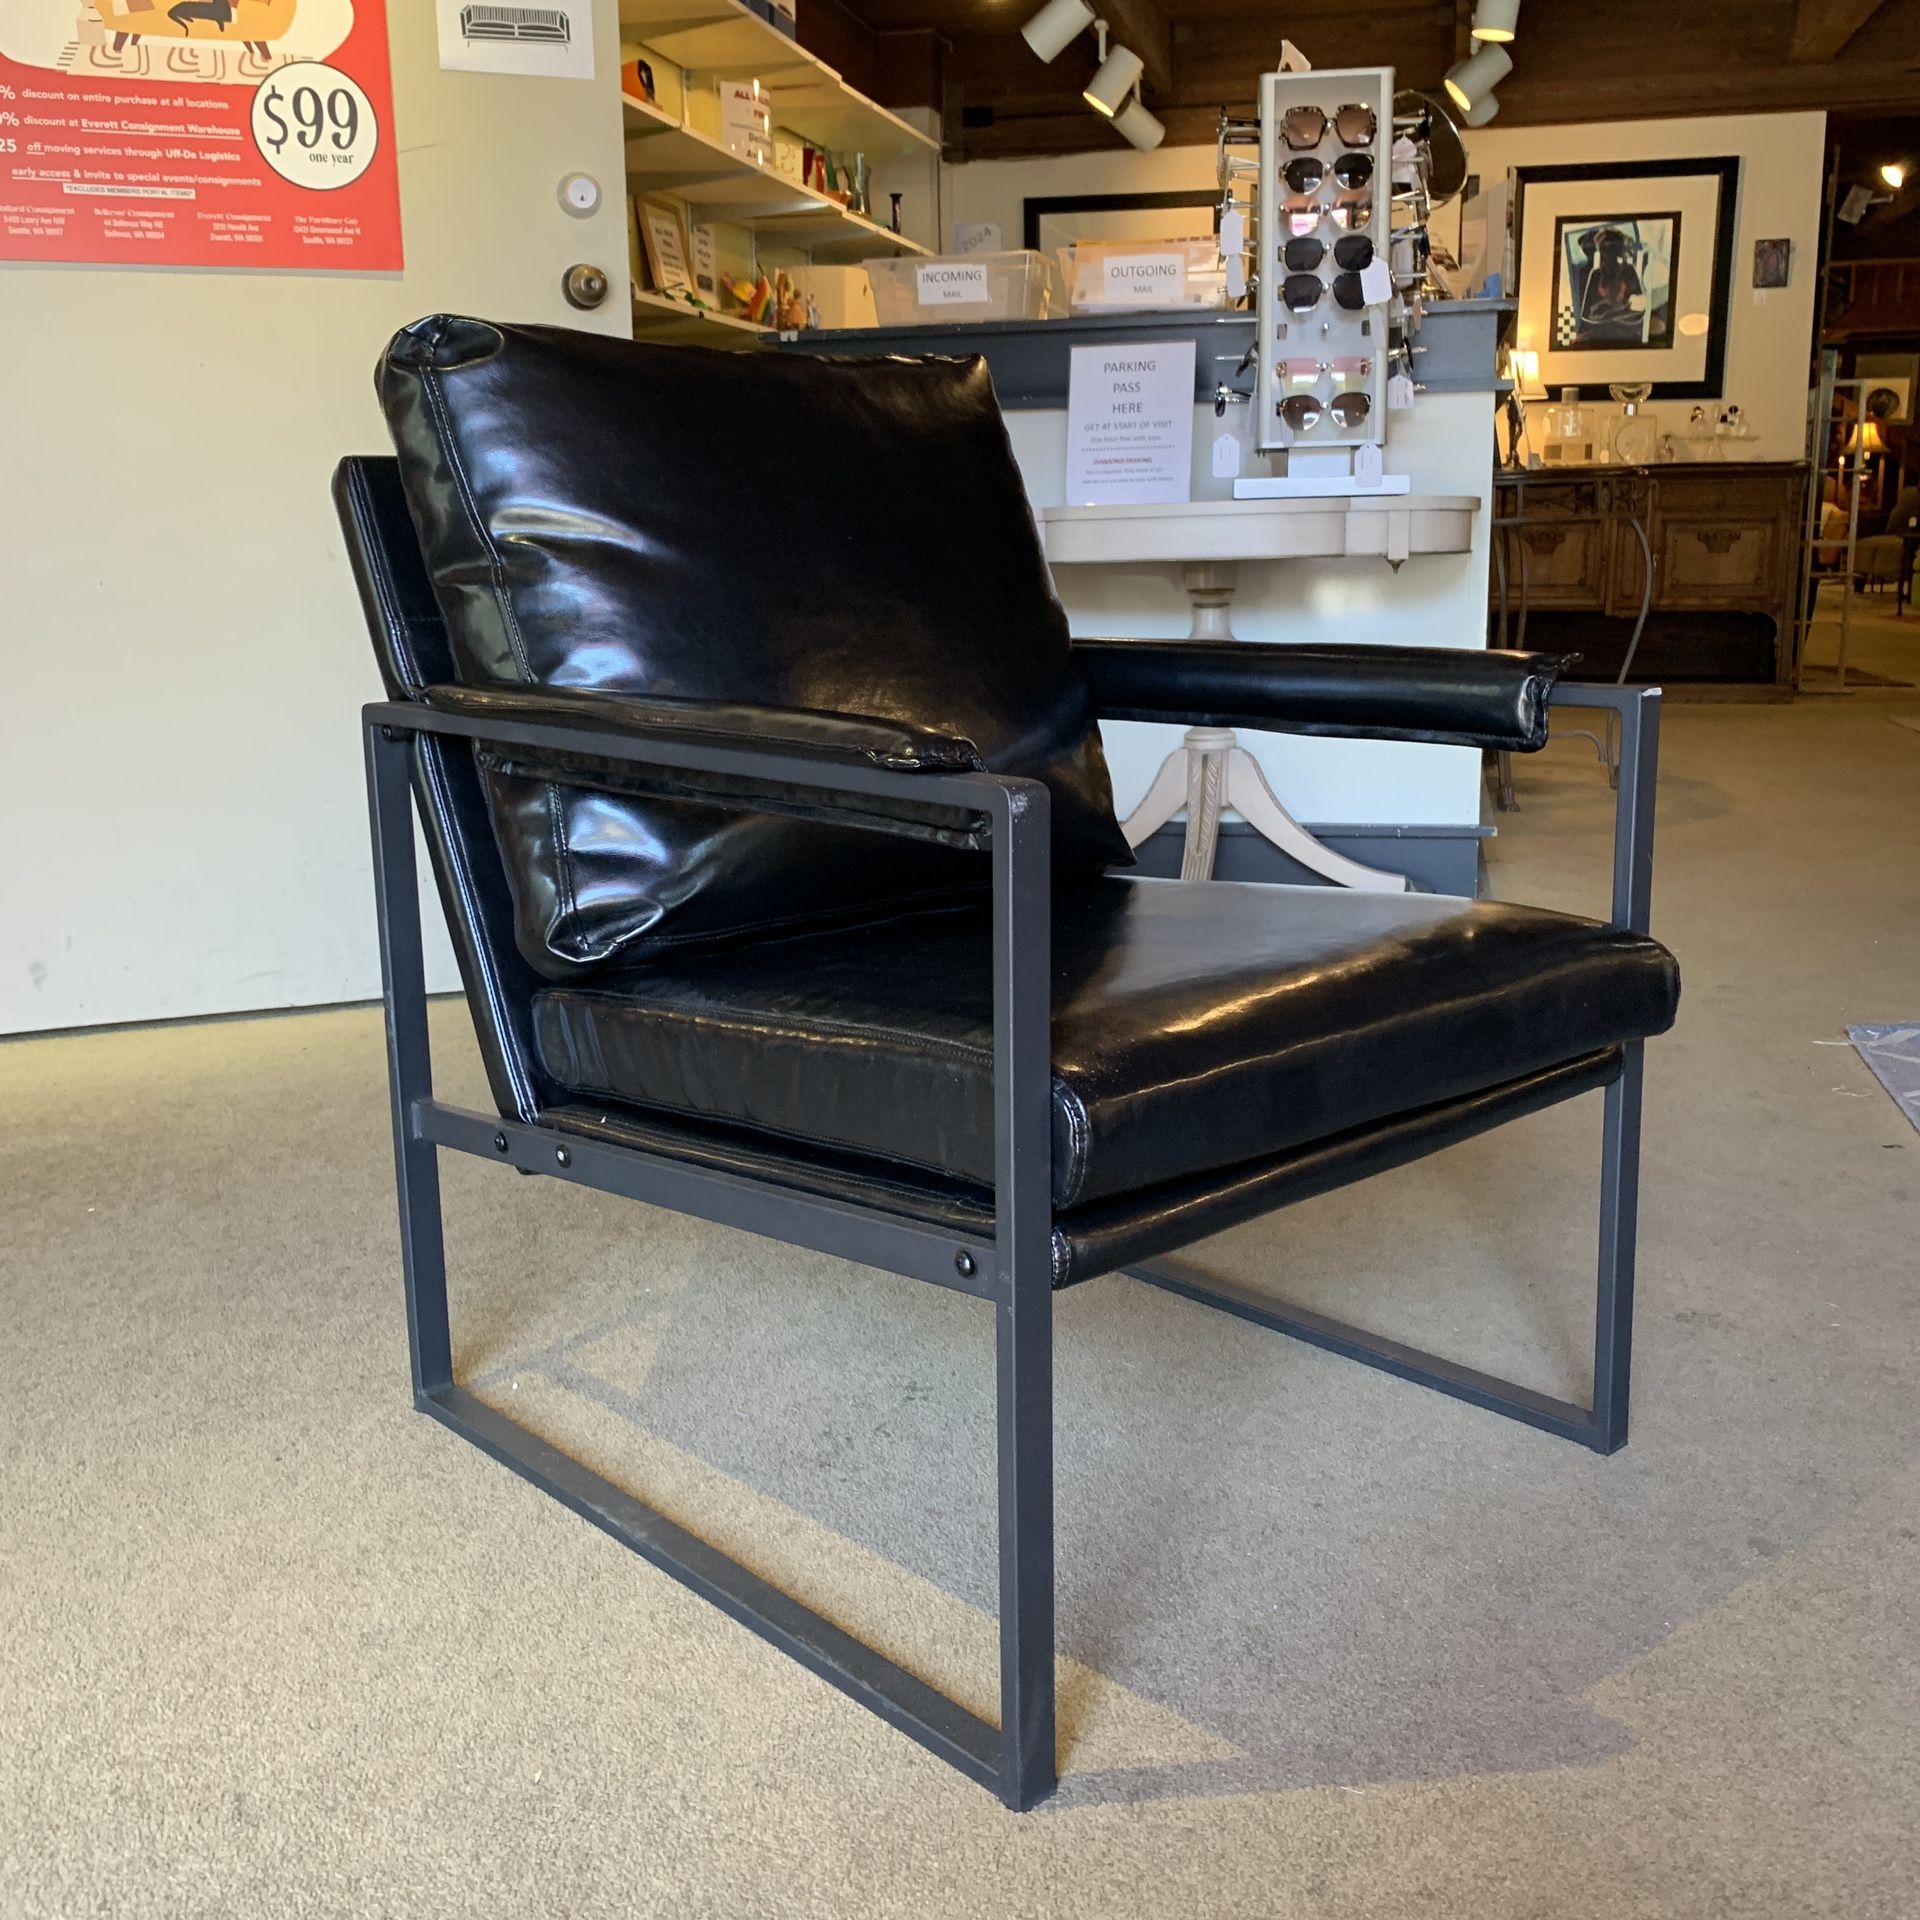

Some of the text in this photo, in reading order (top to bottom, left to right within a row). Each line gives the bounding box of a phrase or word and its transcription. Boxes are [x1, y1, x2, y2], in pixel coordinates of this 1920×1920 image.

[22, 88, 64, 101] discount
[67, 93, 80, 101] on
[82, 93, 112, 103] entire
[114, 94, 158, 105] purchase
[160, 98, 170, 106] at
[173, 97, 184, 107] all
[186, 98, 229, 110] locations
[23, 115, 66, 127] discount
[69, 119, 79, 127] at
[81, 118, 119, 129] Everett
[121, 120, 185, 134] Consignment
[186, 123, 241, 136] Warehouse
[263, 84, 359, 154] $99
[27, 142, 42, 152] off
[44, 144, 81, 156] moving
[83, 145, 122, 157] services
[124, 146, 162, 160] through
[199, 150, 241, 163] Logistics
[309, 153, 354, 167] one year
[11, 166, 36, 178] early
[39, 169, 71, 179] access
[73, 168, 81, 178] &
[84, 169, 112, 180] invite
[113, 171, 125, 181] to
[127, 172, 160, 183] special
[922, 270, 982, 284] INCOMING
[1111, 264, 1177, 278] OUTGOING
[942, 290, 962, 298] MAIL
[1133, 285, 1154, 294] MAIL
[1103, 360, 1156, 373] PARKING
[1112, 382, 1141, 393] PASS
[1112, 402, 1143, 414] HERE
[1083, 420, 1173, 432] GET AT START OF VISIT
